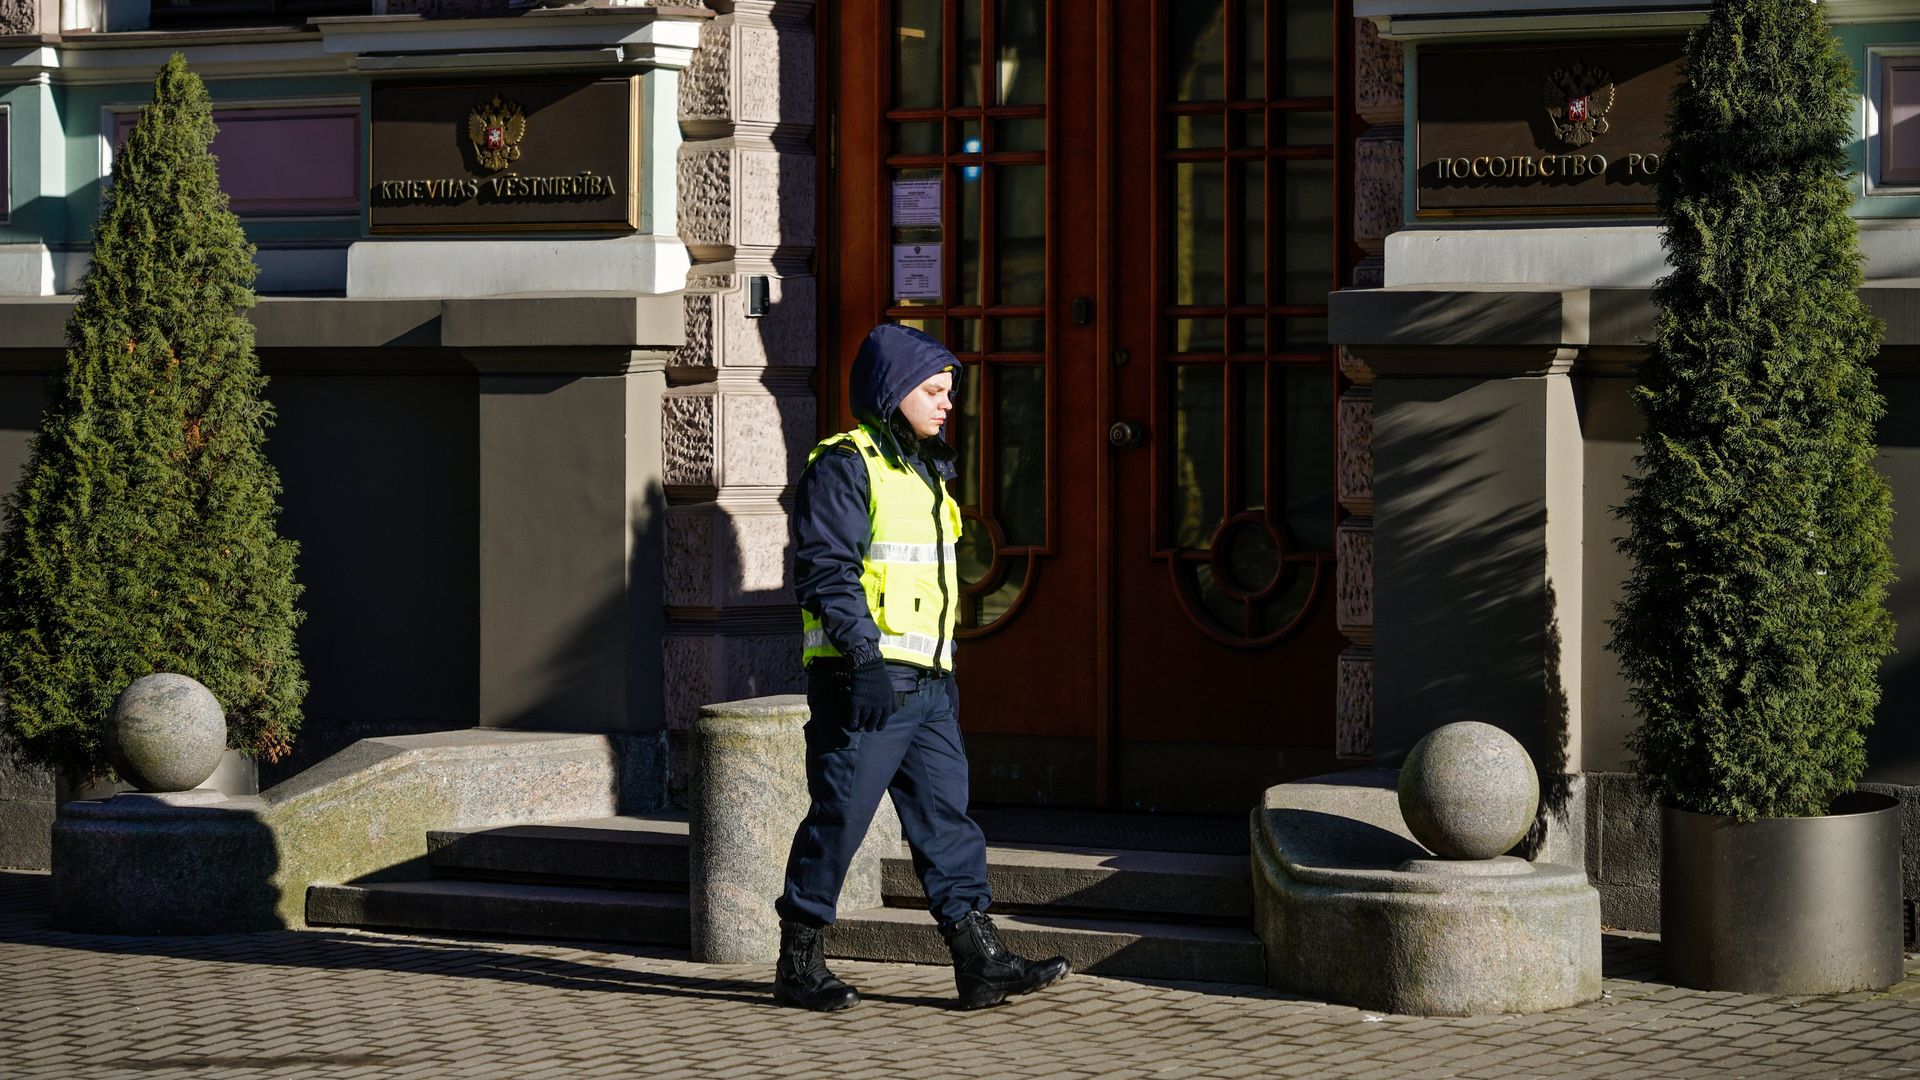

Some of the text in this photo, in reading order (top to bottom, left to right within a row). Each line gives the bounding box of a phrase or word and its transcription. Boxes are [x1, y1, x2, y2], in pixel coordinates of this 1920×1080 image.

[1437, 152, 1660, 179] ПОСОЛЬСТВО РО
[382, 171, 616, 199] KRIEVIJAS VĒSTNIECĪBA
